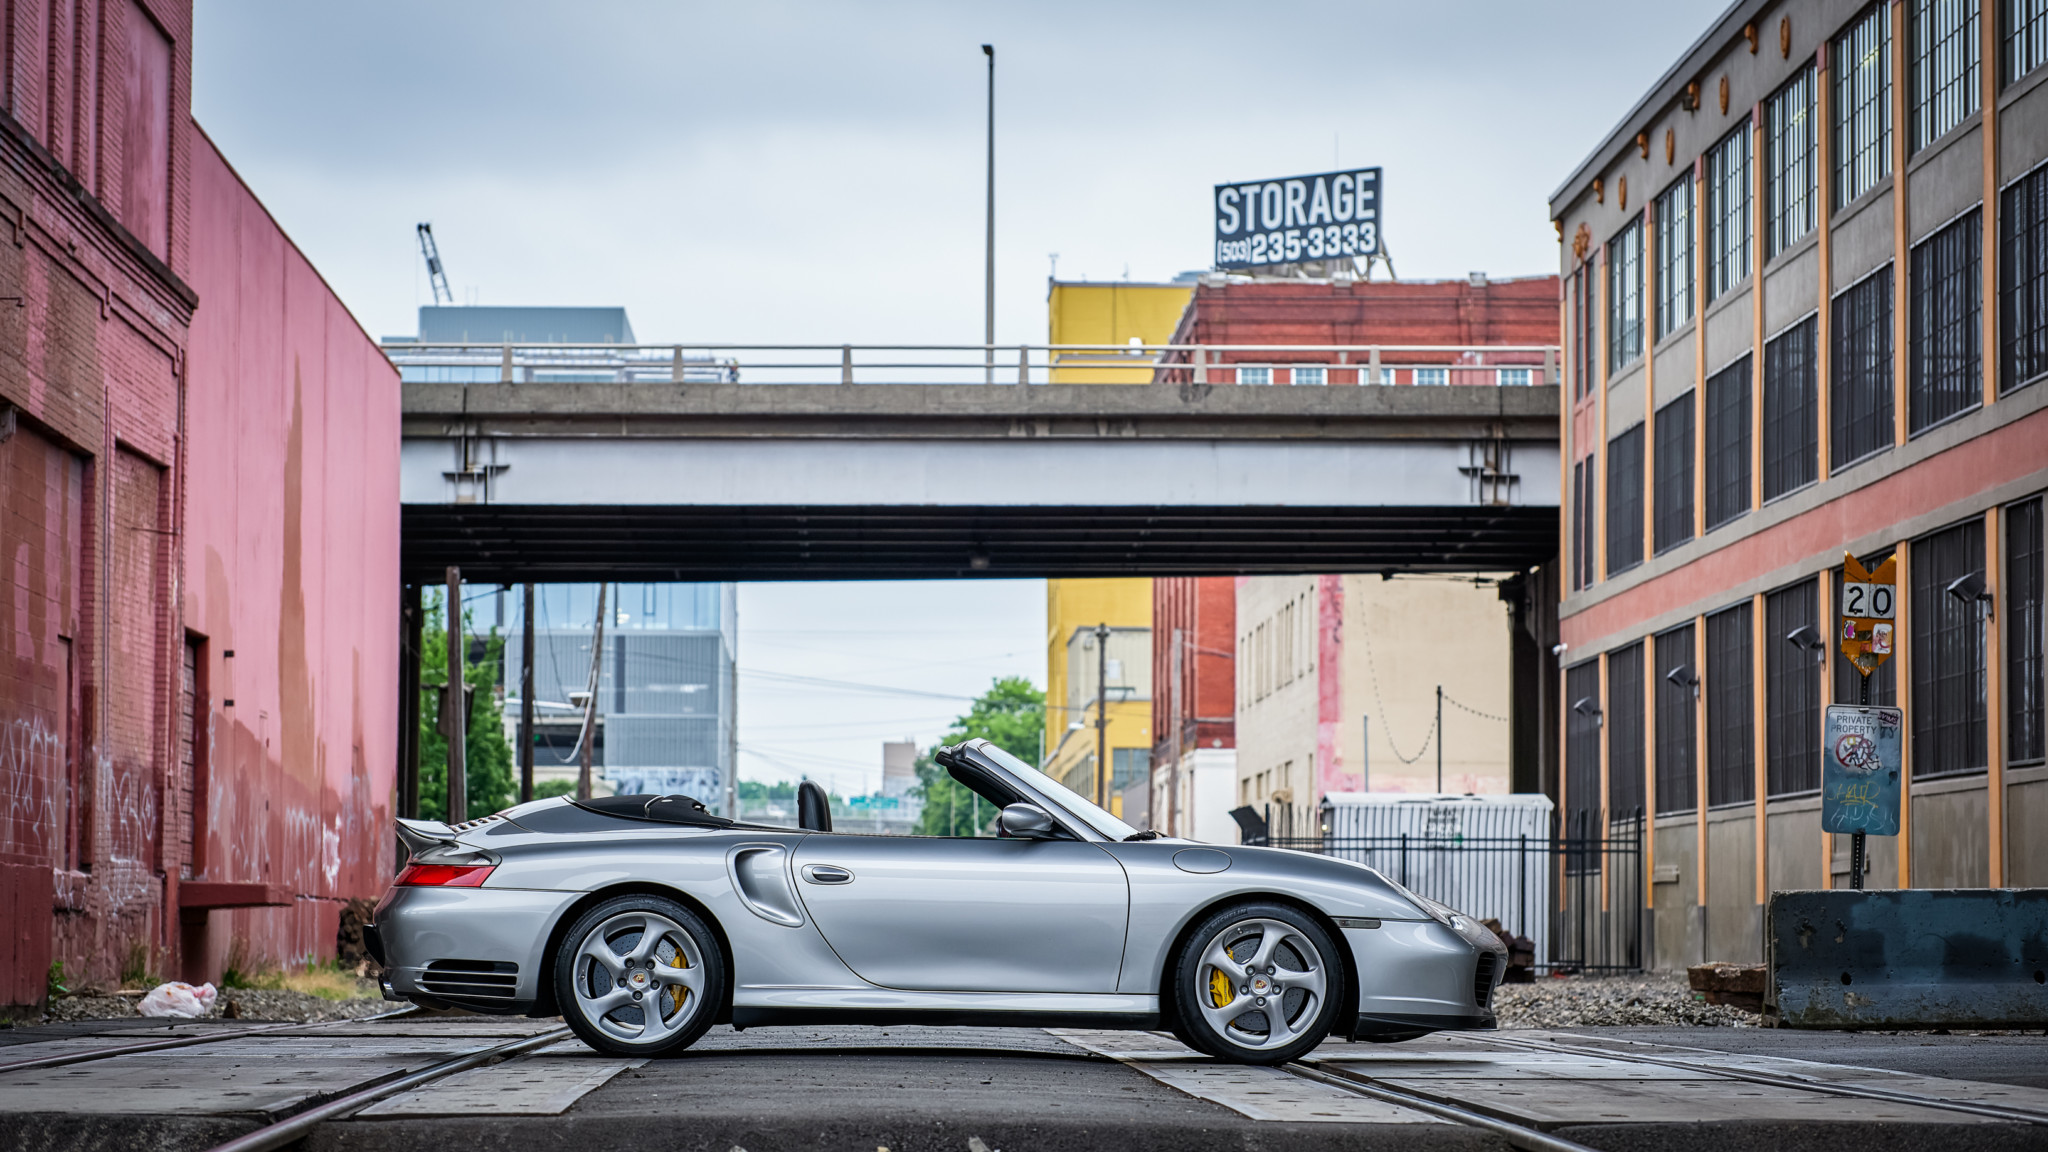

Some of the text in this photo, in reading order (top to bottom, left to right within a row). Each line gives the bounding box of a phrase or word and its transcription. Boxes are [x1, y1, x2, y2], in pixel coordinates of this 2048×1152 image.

[1218, 171, 1376, 235] STORAGE
[1848, 585, 1892, 615] 20
[1830, 724, 1877, 735] PROPERTY
[1836, 715, 1872, 725] PRIVATE
